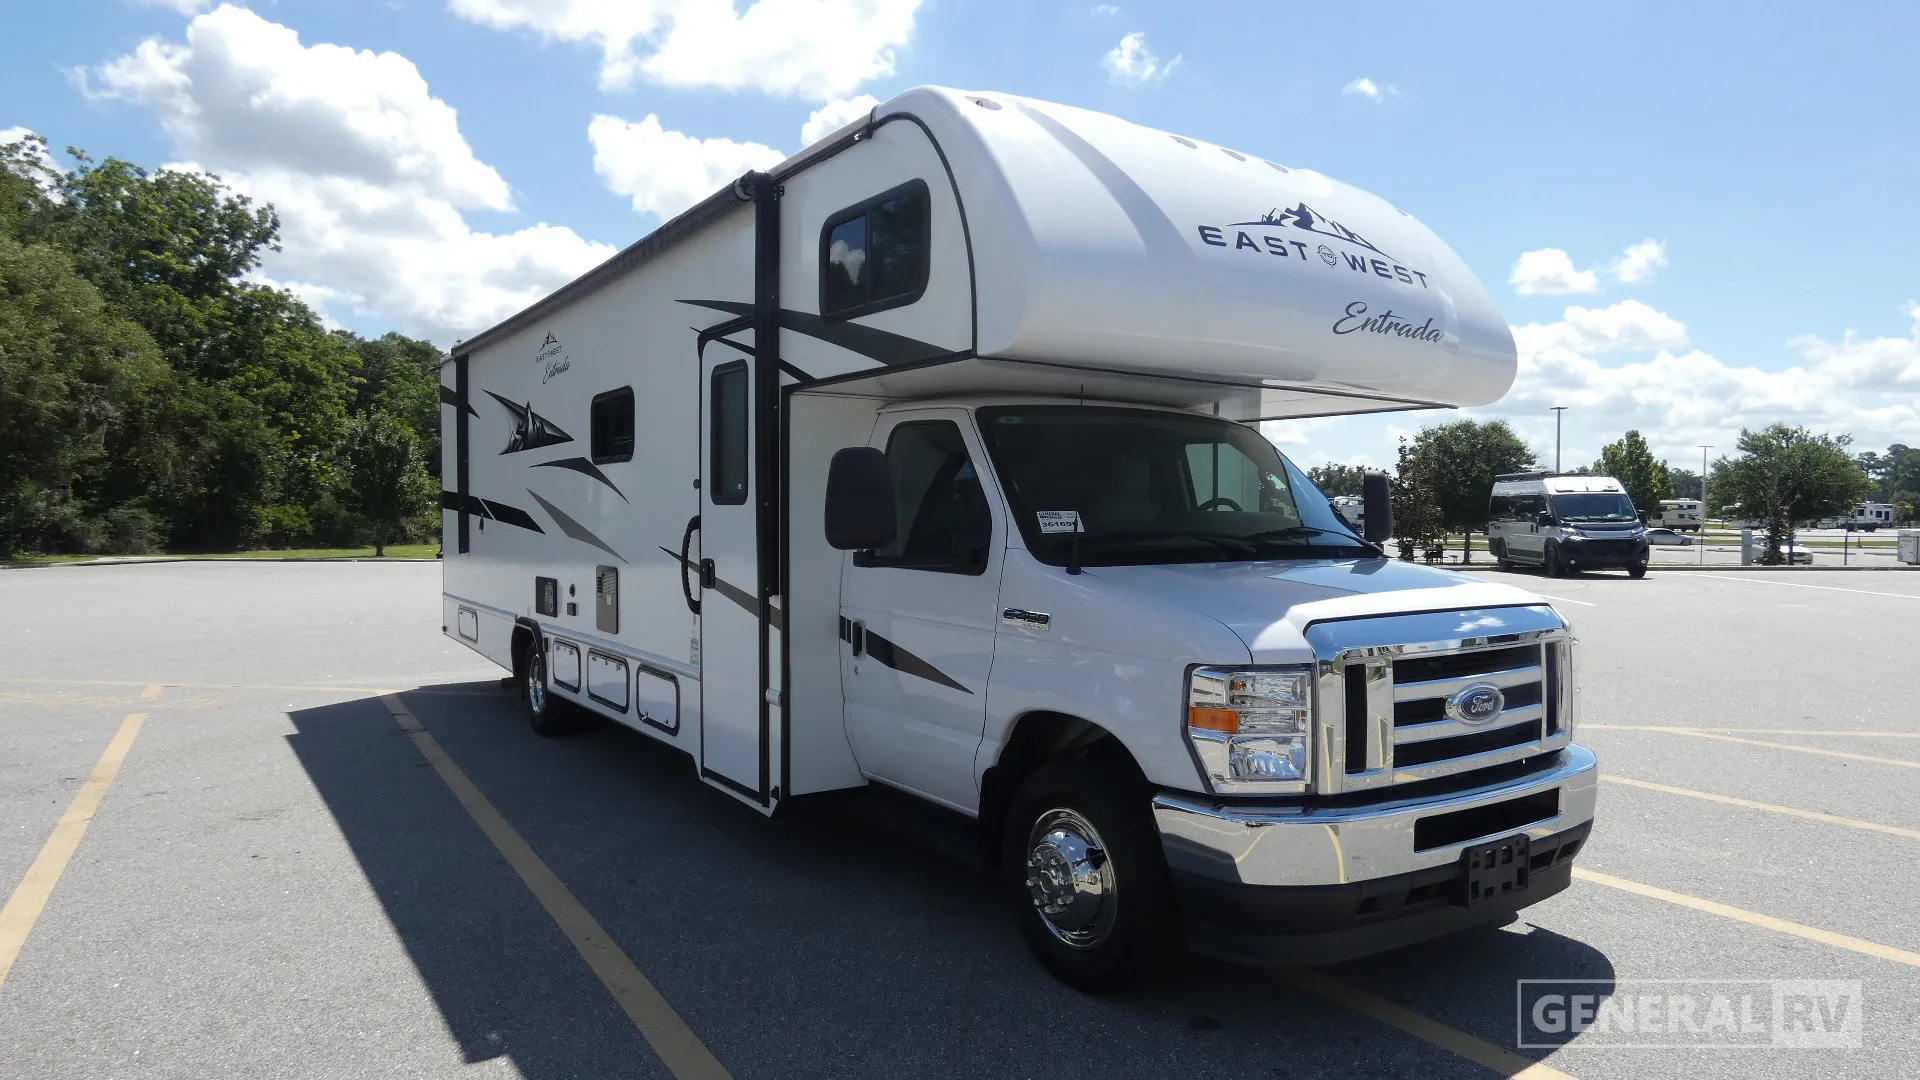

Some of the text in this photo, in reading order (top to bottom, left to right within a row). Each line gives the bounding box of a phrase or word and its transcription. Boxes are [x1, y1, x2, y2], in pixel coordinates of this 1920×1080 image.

[1198, 225, 1308, 261] EAST
[1341, 251, 1428, 289] WEST
[1332, 301, 1444, 343] Entrada
[1471, 695, 1494, 713] Ford
